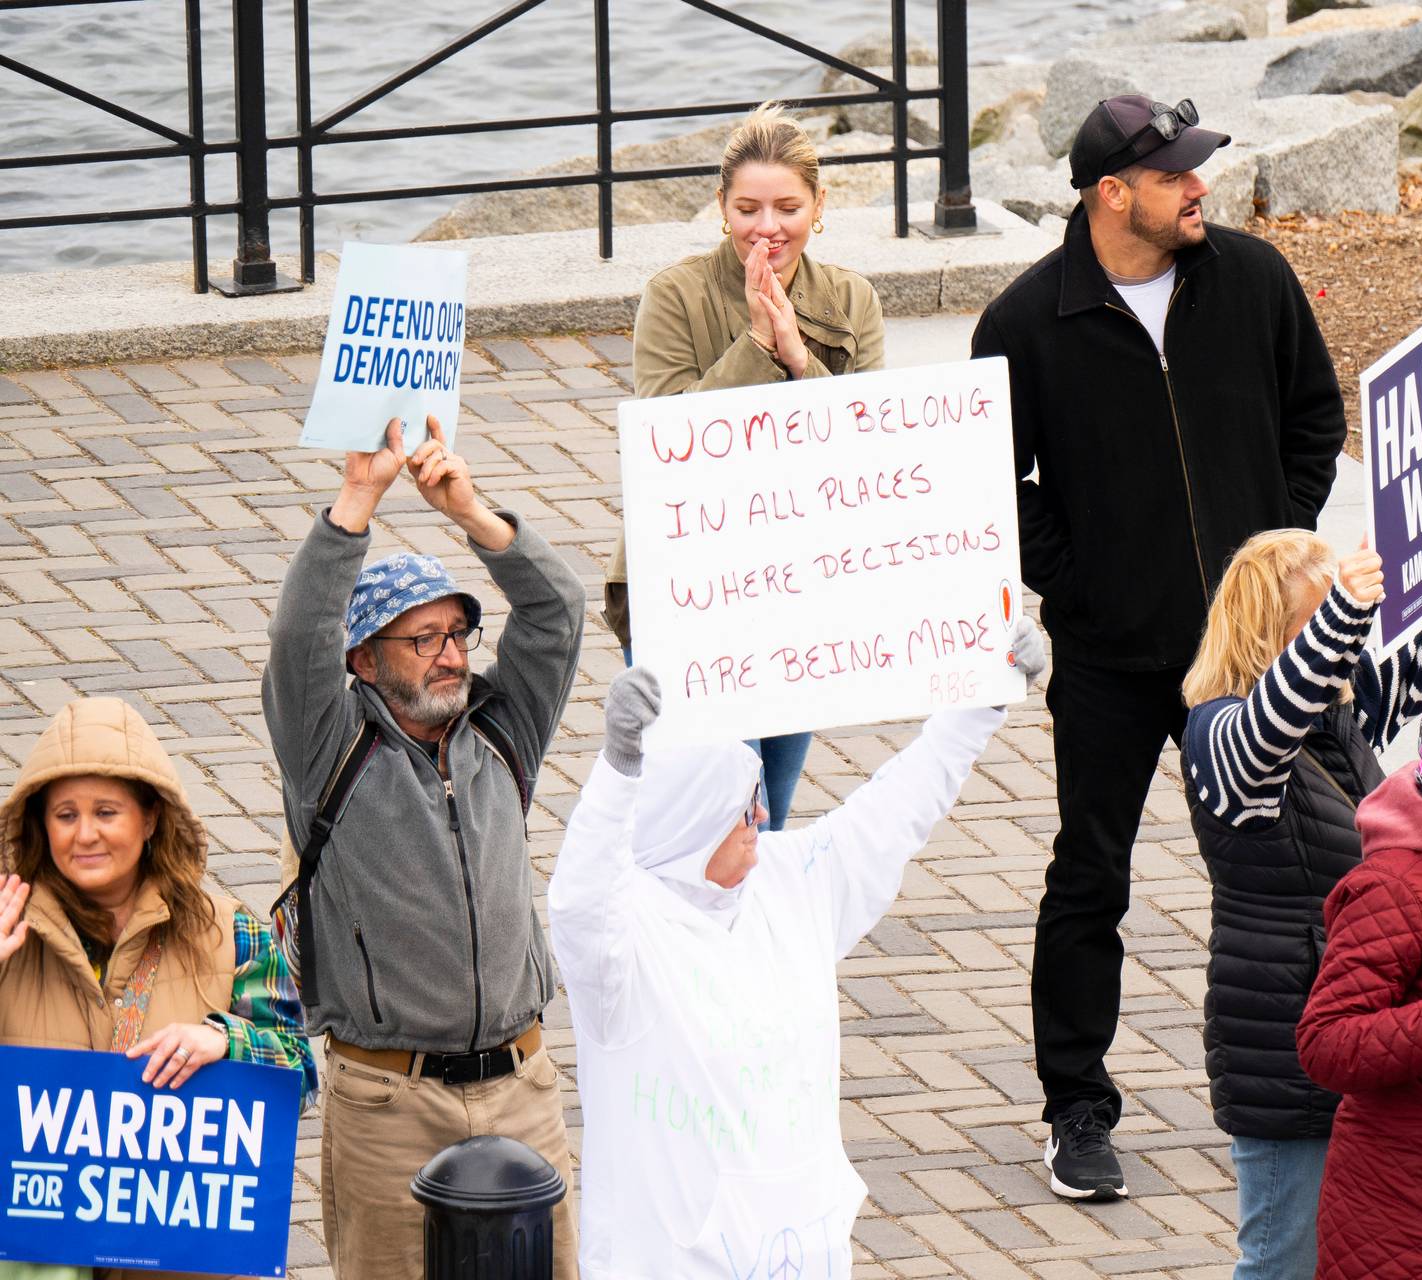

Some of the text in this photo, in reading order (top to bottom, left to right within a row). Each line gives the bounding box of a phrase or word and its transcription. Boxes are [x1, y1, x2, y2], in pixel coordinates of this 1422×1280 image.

[343, 295, 464, 343] DEFEND OUR
[333, 343, 460, 391] DEMOCRACY
[651, 388, 993, 463] WOMEN BELONG
[665, 464, 932, 539] IN ALL PLACES
[671, 524, 1001, 611] WHERE DECISIONS
[685, 655, 757, 698] ARE
[770, 635, 894, 683] BEING
[930, 670, 979, 702] RBG
[17, 1085, 266, 1168] WARREN
[634, 1072, 759, 1153] HUMAN
[12, 1164, 259, 1231] FOR SENATE
